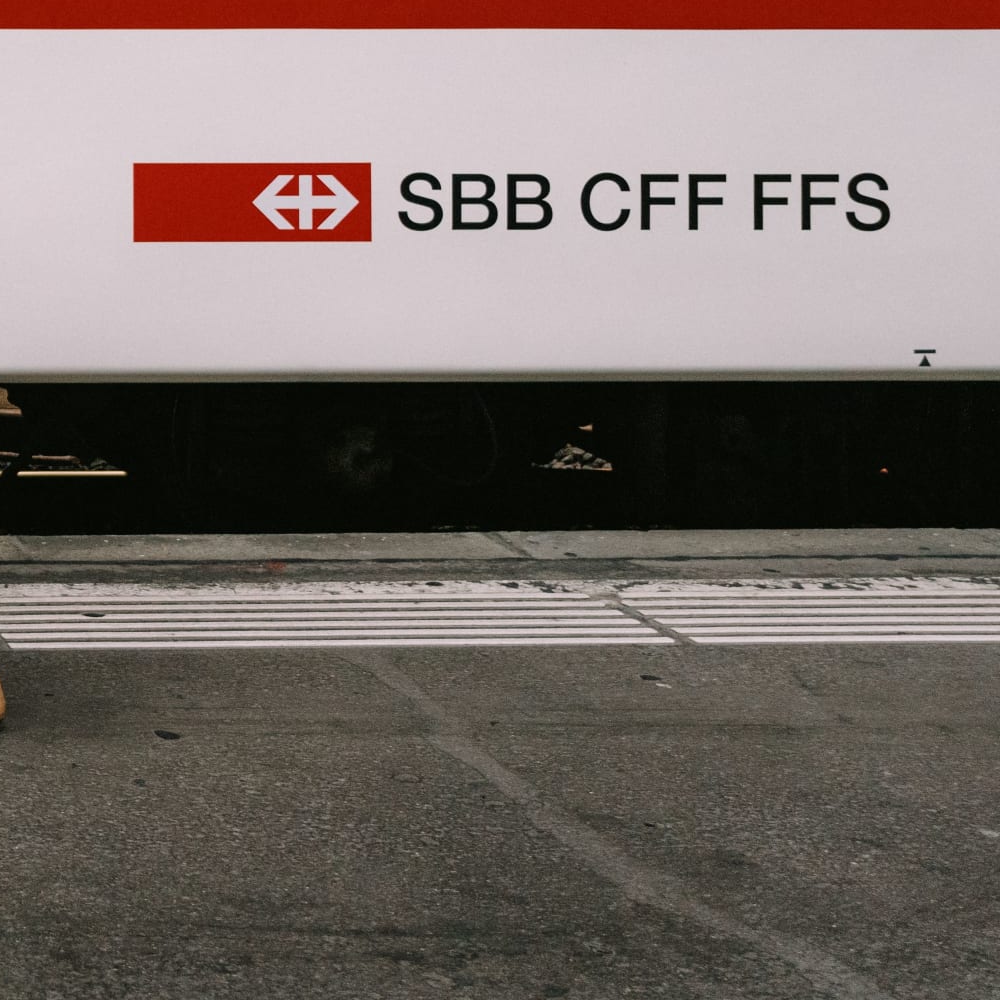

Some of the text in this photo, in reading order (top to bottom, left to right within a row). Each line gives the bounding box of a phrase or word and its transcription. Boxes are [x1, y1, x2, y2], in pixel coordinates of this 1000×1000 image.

[397, 172, 892, 232] SBB CFF FFS
